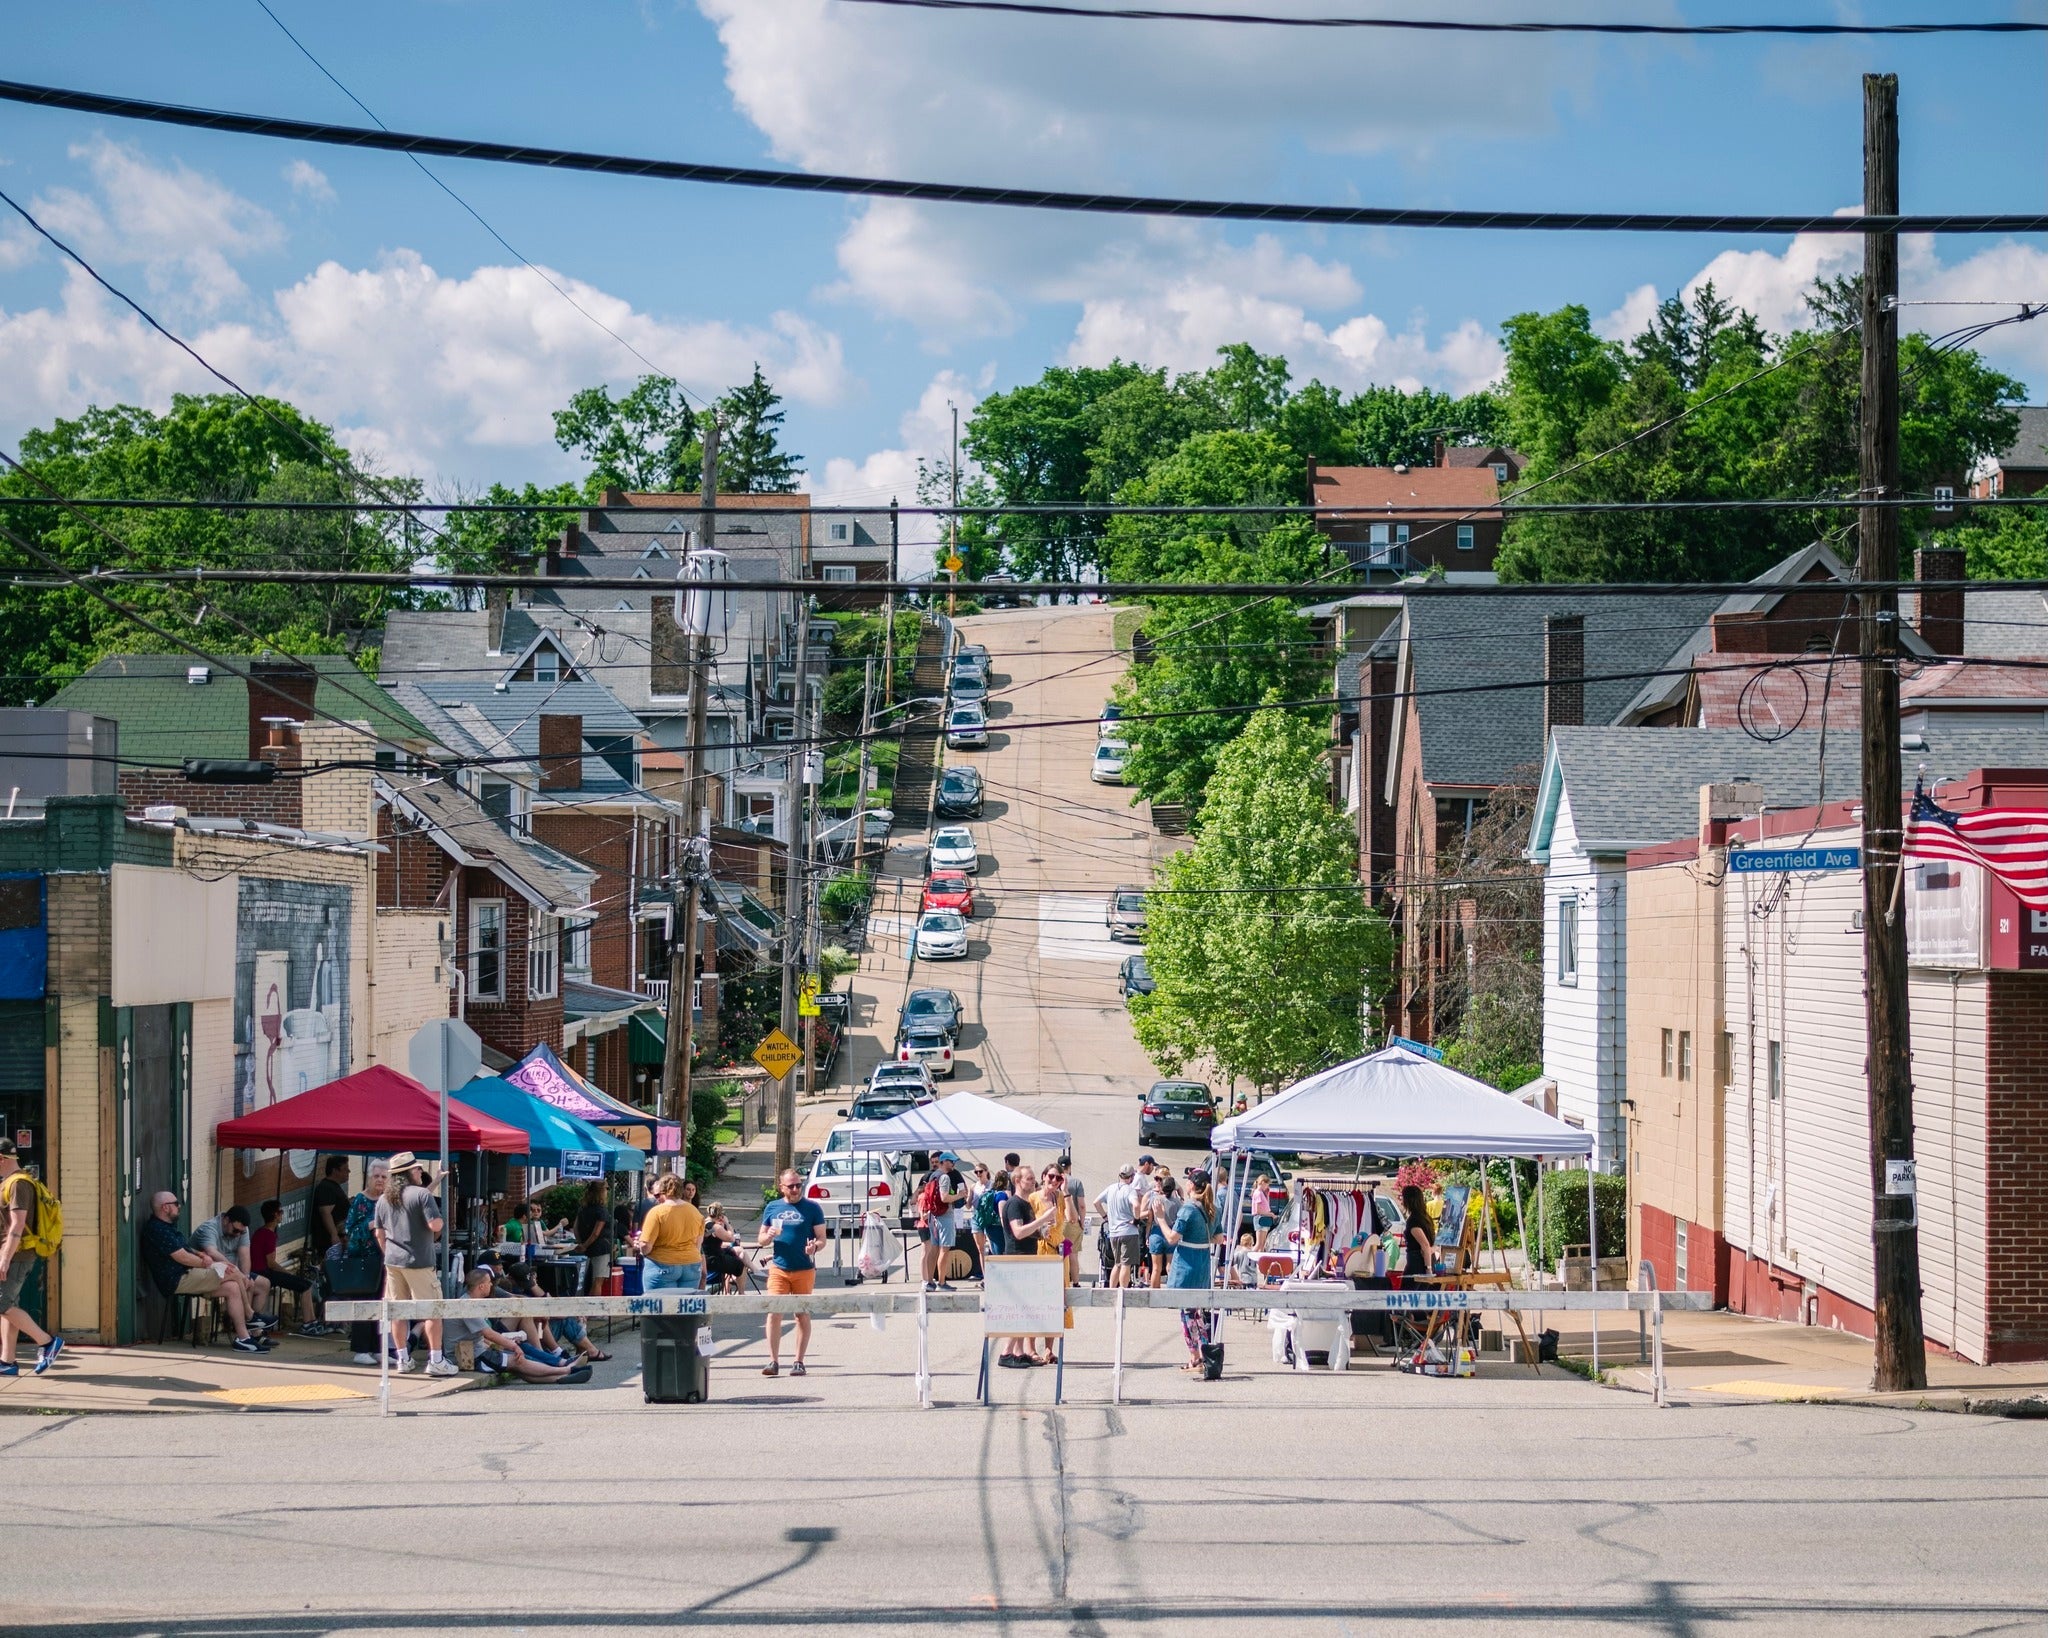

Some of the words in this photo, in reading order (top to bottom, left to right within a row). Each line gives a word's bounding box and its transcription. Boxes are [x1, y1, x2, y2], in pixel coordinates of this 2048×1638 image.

[1736, 852, 1816, 869] Greenfield
[1824, 852, 1851, 866] Ave
[2000, 919, 2009, 933] 521
[766, 1043, 789, 1051] WATCH
[761, 1053, 796, 1061] CHILDREN
[1903, 1165, 1911, 1173] NO
[1386, 1294, 1420, 1308] DPW
[1426, 1292, 1467, 1308] DIV-2
